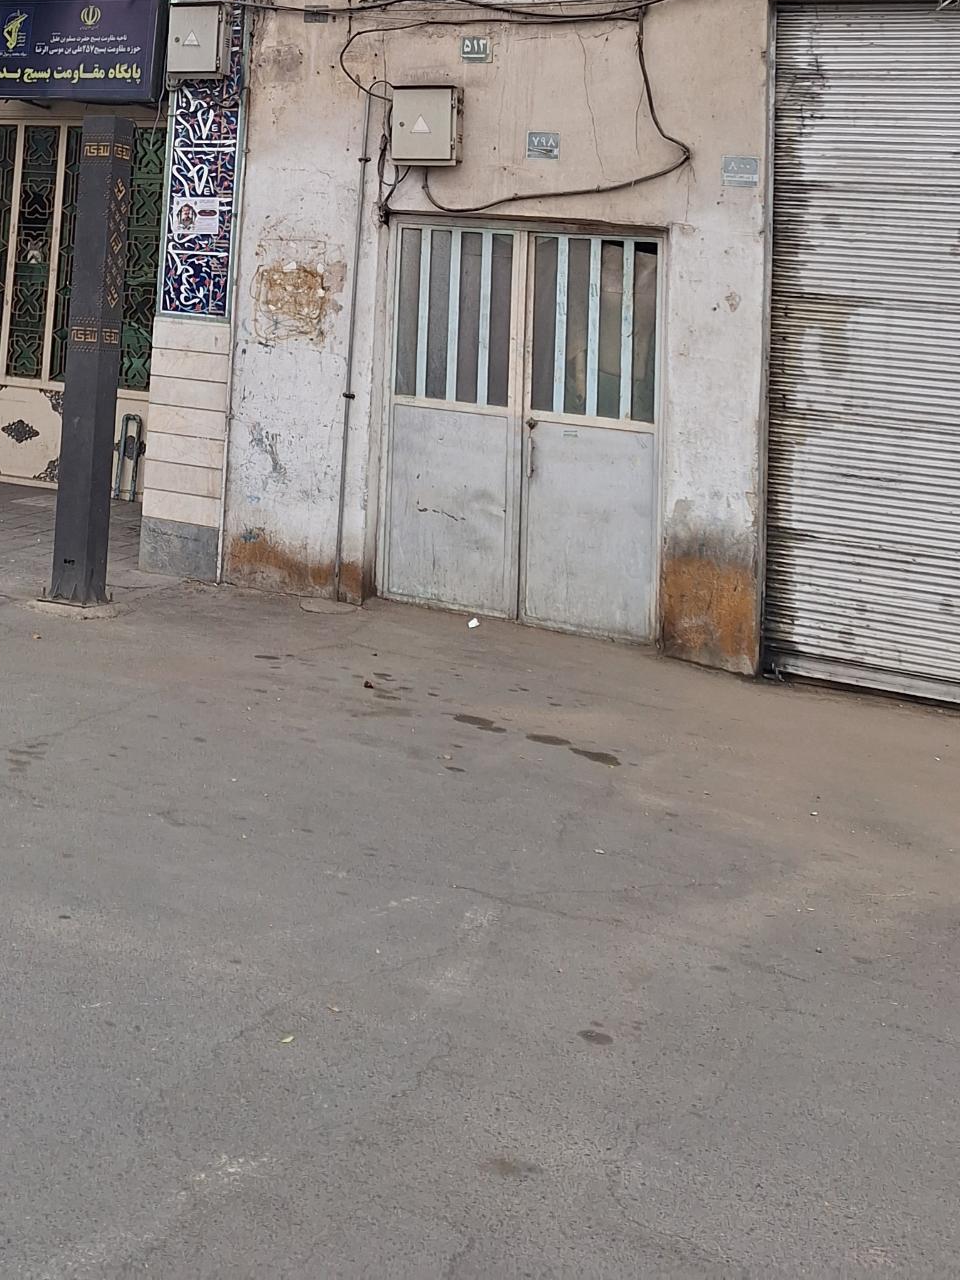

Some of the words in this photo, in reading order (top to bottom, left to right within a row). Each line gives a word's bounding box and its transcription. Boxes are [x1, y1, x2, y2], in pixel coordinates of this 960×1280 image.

[107, 44, 126, 54] مقاومت
[126, 45, 141, 54] حوزه
[23, 66, 51, 83] بسیج
[53, 63, 106, 84] مقاومت
[108, 62, 141, 84] پایگاه
